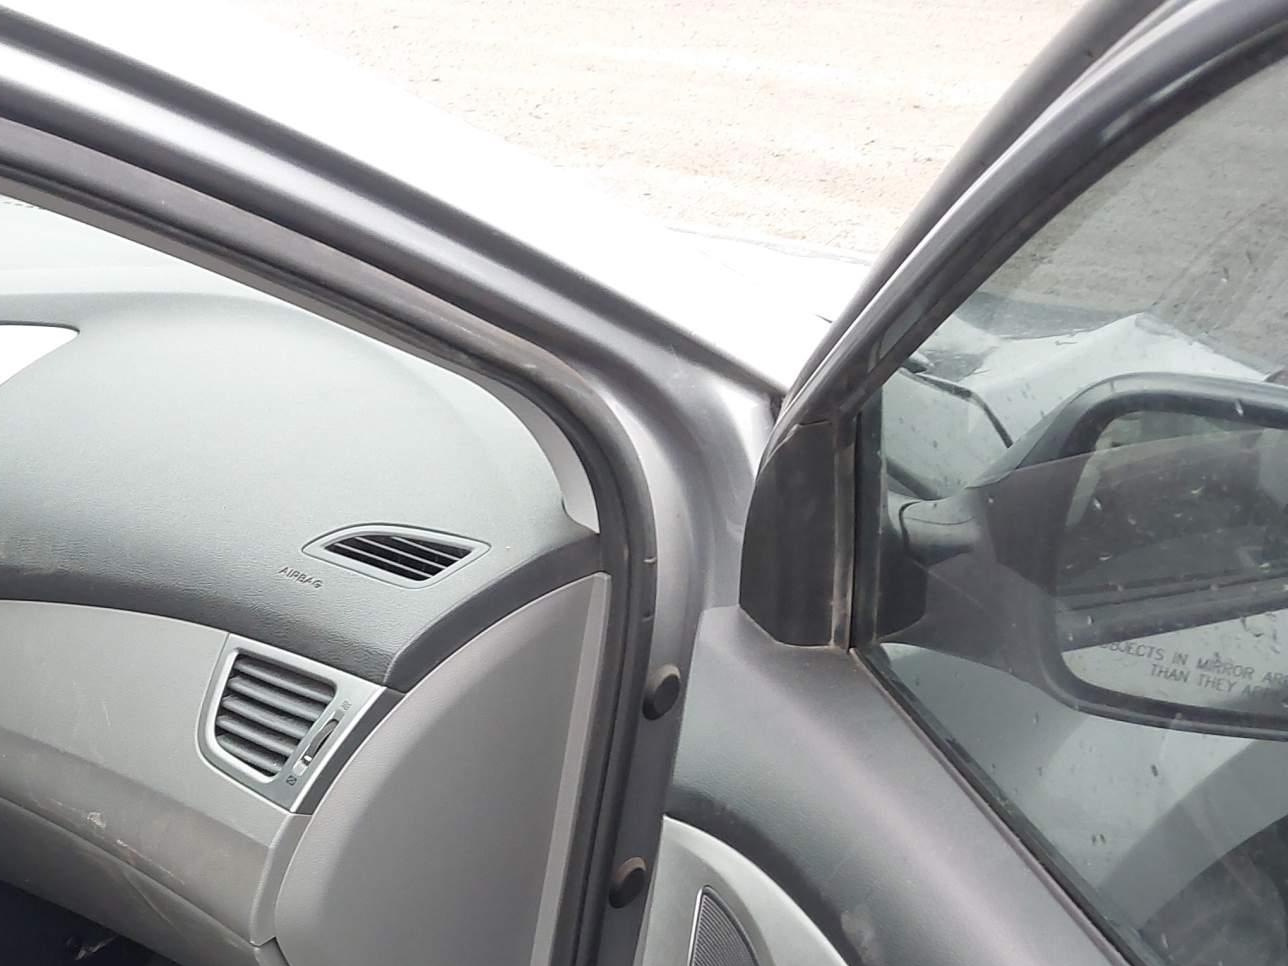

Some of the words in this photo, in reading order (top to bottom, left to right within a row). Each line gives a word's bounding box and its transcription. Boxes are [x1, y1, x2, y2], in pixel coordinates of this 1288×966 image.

[278, 566, 323, 589] AIRBAG
[1172, 652, 1189, 665] IN
[1149, 664, 1189, 683] THAN
[1197, 674, 1238, 693] THEY
